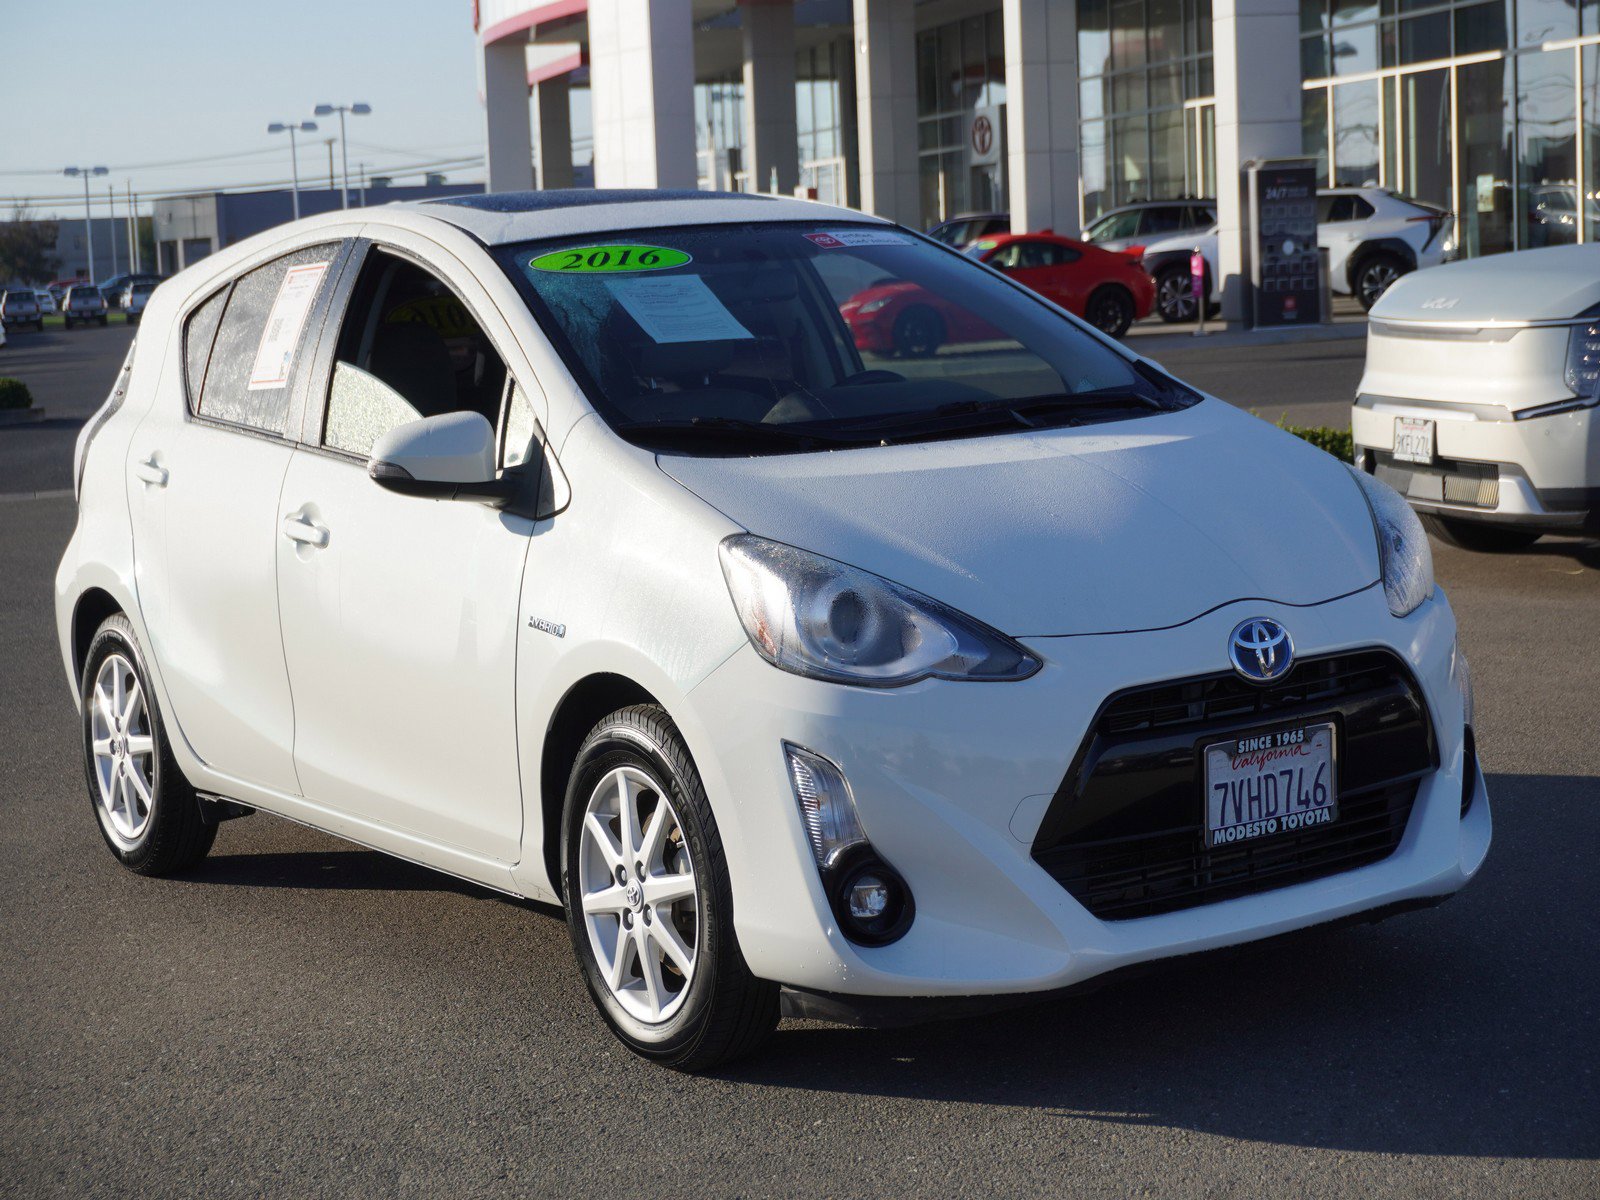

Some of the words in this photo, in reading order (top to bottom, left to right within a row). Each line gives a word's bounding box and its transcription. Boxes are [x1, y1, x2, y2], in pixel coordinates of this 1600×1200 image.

[559, 250, 661, 270] 2016
[528, 615, 560, 636] HYBRID
[1238, 736, 1272, 753] SINCE
[1276, 730, 1304, 747] 1965
[1232, 744, 1312, 772] California
[1214, 762, 1327, 826] 7VHD746
[1213, 820, 1277, 845] MODESTO
[1281, 808, 1331, 831] TOYOTA
